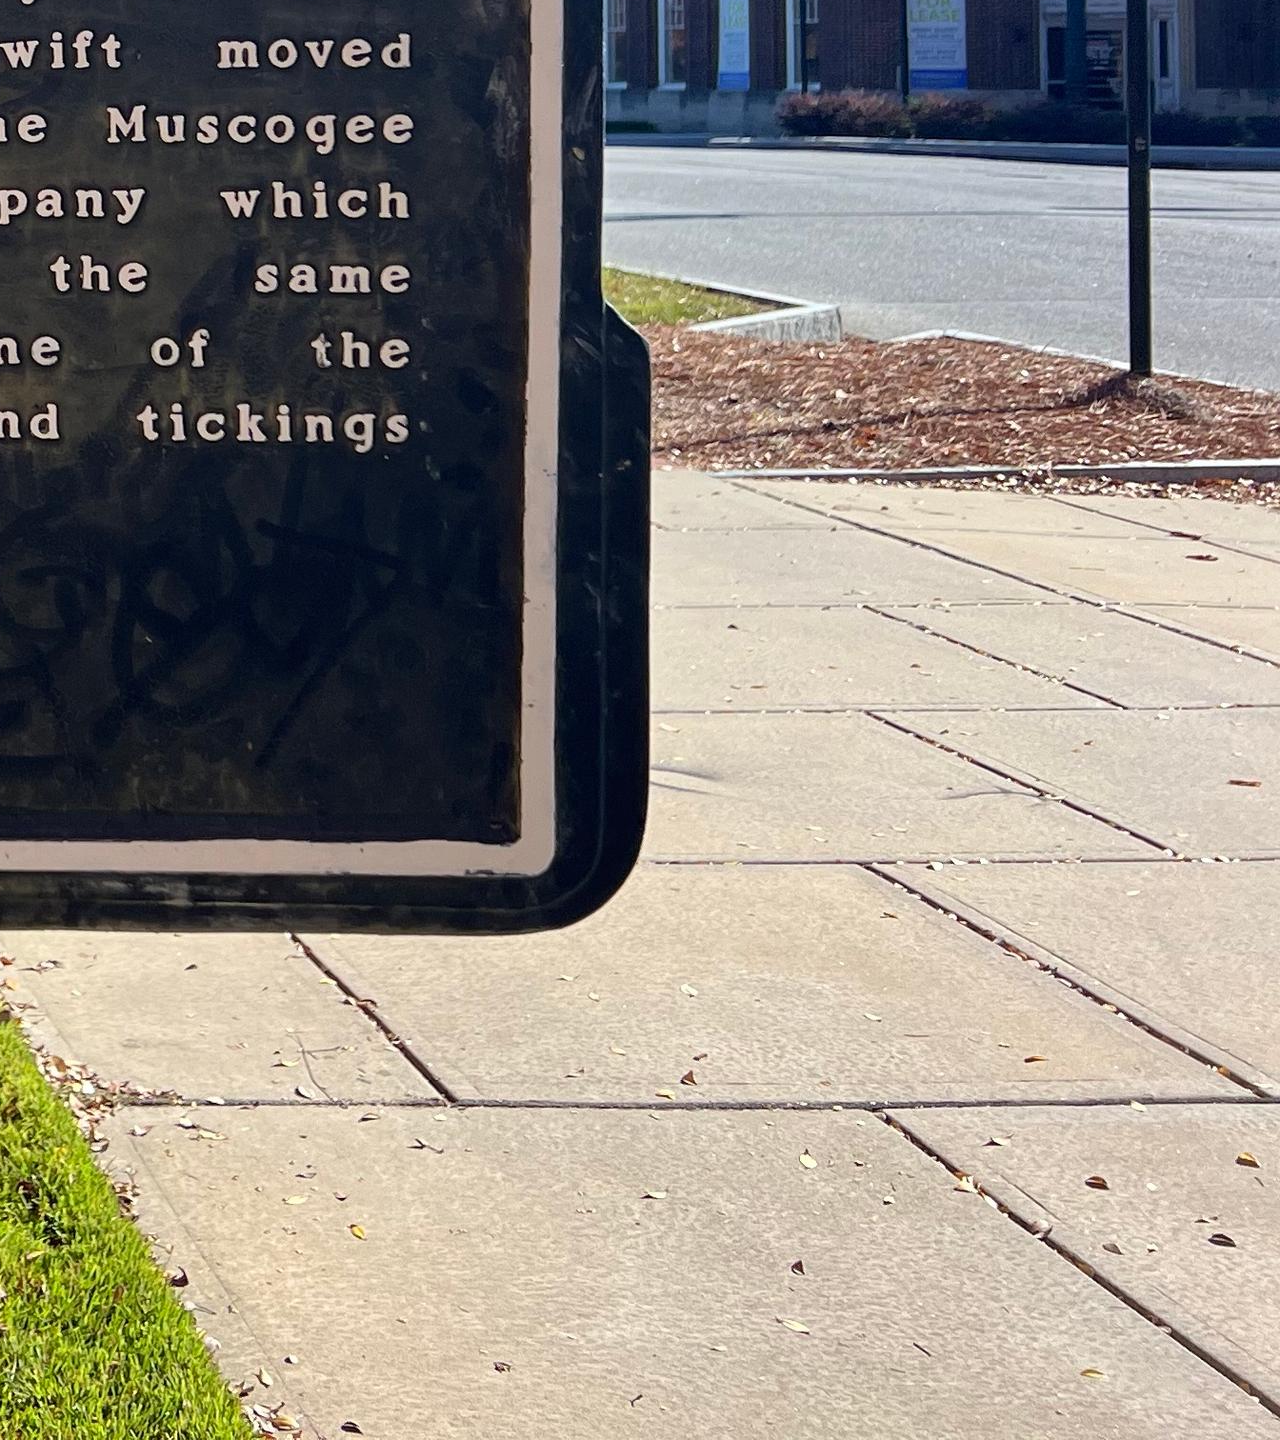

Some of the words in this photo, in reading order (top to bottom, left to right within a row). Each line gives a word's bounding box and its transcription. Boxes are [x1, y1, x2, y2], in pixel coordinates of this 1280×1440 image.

[910, 9, 960, 22] LEASE
[217, 33, 411, 69] moved
[106, 104, 414, 155] Muscogee
[219, 181, 410, 219] which
[49, 254, 148, 293] the
[254, 264, 410, 293] same
[150, 328, 210, 368] of
[310, 331, 410, 369] the
[136, 402, 409, 453] tickings
